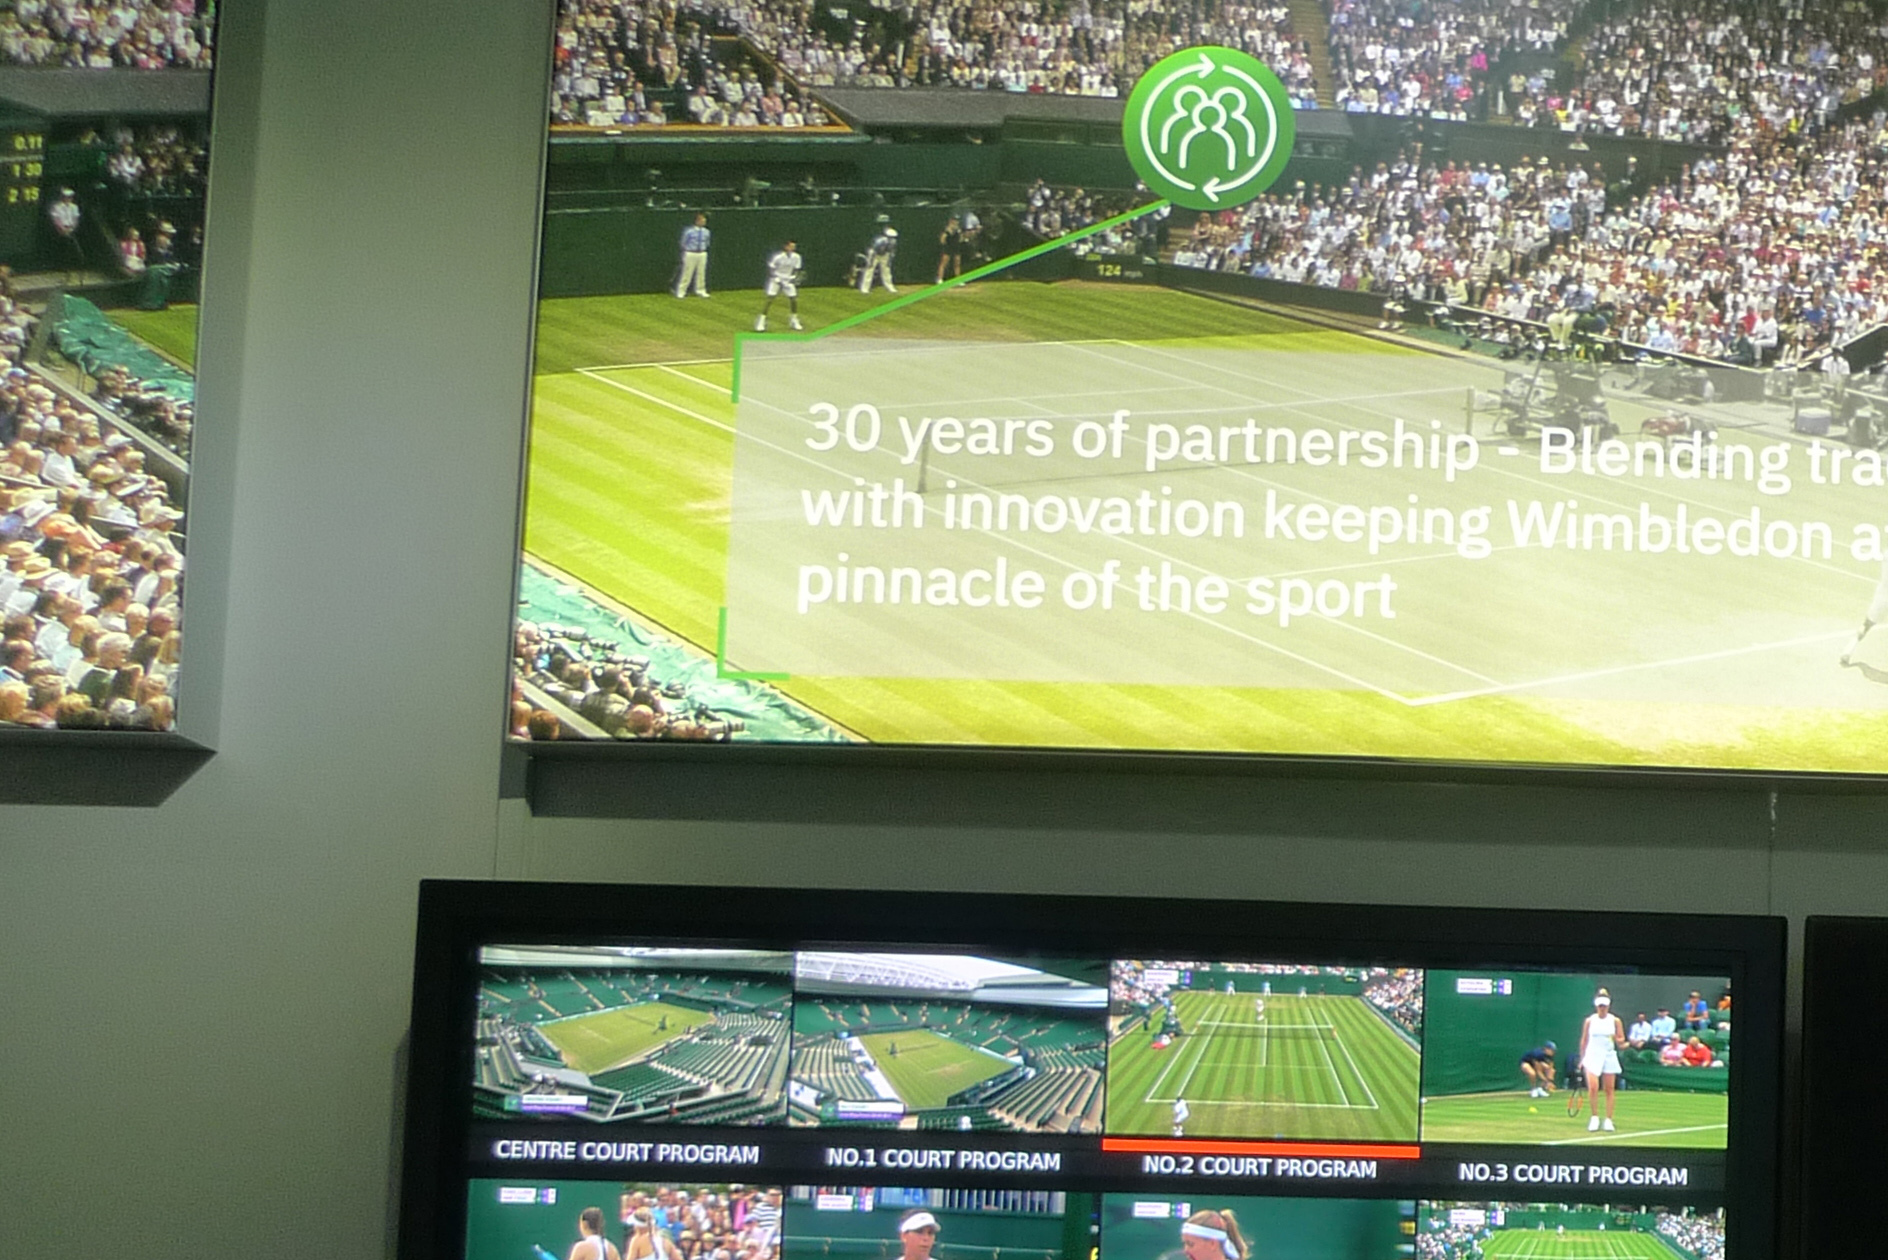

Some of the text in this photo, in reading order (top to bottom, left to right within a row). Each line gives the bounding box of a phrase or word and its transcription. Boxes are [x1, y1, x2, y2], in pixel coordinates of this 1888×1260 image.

[804, 401, 881, 453] 30
[898, 414, 1055, 464] years
[1072, 409, 1131, 460] of
[1145, 418, 1480, 482] partnership
[1539, 426, 1792, 495] Blending
[801, 478, 925, 529] with
[943, 480, 1245, 539] innovation
[1265, 489, 1493, 560] keeping
[1507, 499, 1833, 560] Wimbledon
[797, 552, 1398, 628] pinnacle of the sport
[494, 1139, 760, 1164] CENTRE COURT PROGRAM
[826, 1147, 1061, 1171] NO.1 COURT PROGRAM
[1143, 1154, 1377, 1179] NO.2 COURT PROGRAM
[1459, 1162, 1688, 1186] NO.3 COURT PROGRAM
